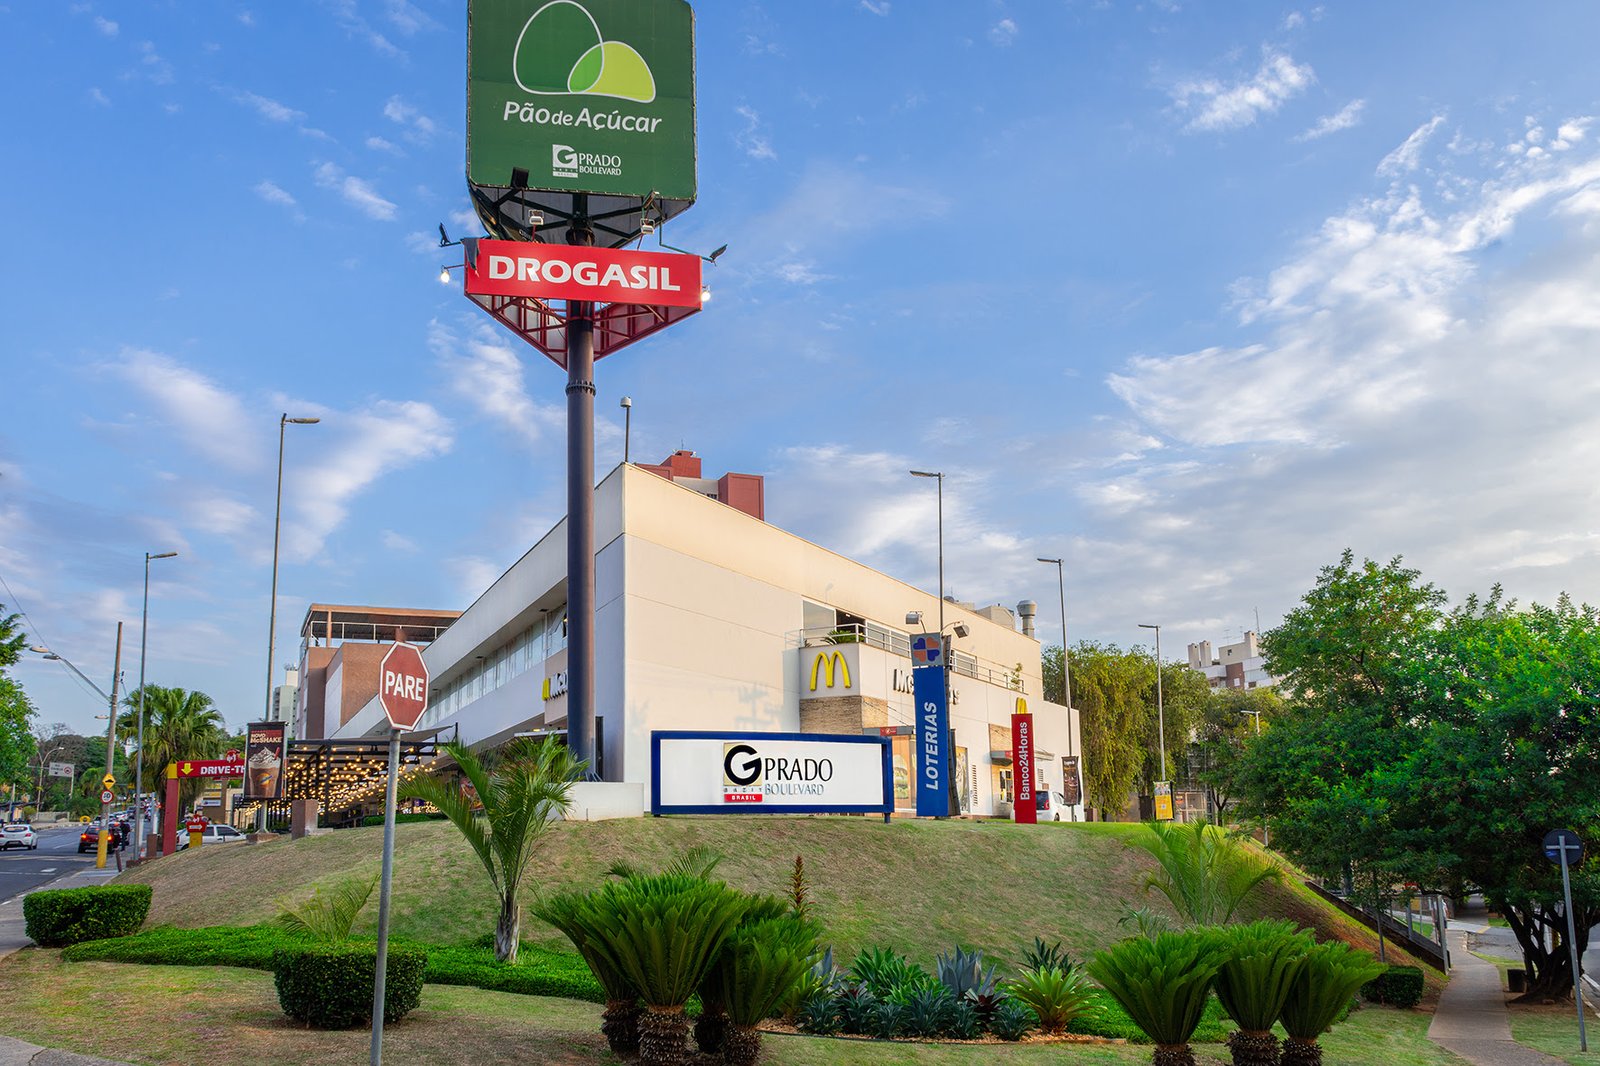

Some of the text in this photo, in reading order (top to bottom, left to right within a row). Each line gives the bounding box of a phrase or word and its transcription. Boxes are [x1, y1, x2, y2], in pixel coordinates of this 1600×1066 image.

[503, 101, 662, 133] Pão de Açúcar
[579, 152, 621, 168] PRADO
[579, 165, 622, 176] BOULEVARD
[488, 255, 681, 292] DROGASIL
[384, 670, 425, 702] PARE
[924, 701, 939, 791] LOTERIAS
[1018, 721, 1031, 801] Banco24Horas
[764, 757, 833, 782] PRADO
[764, 783, 825, 796] BOULEVARD
